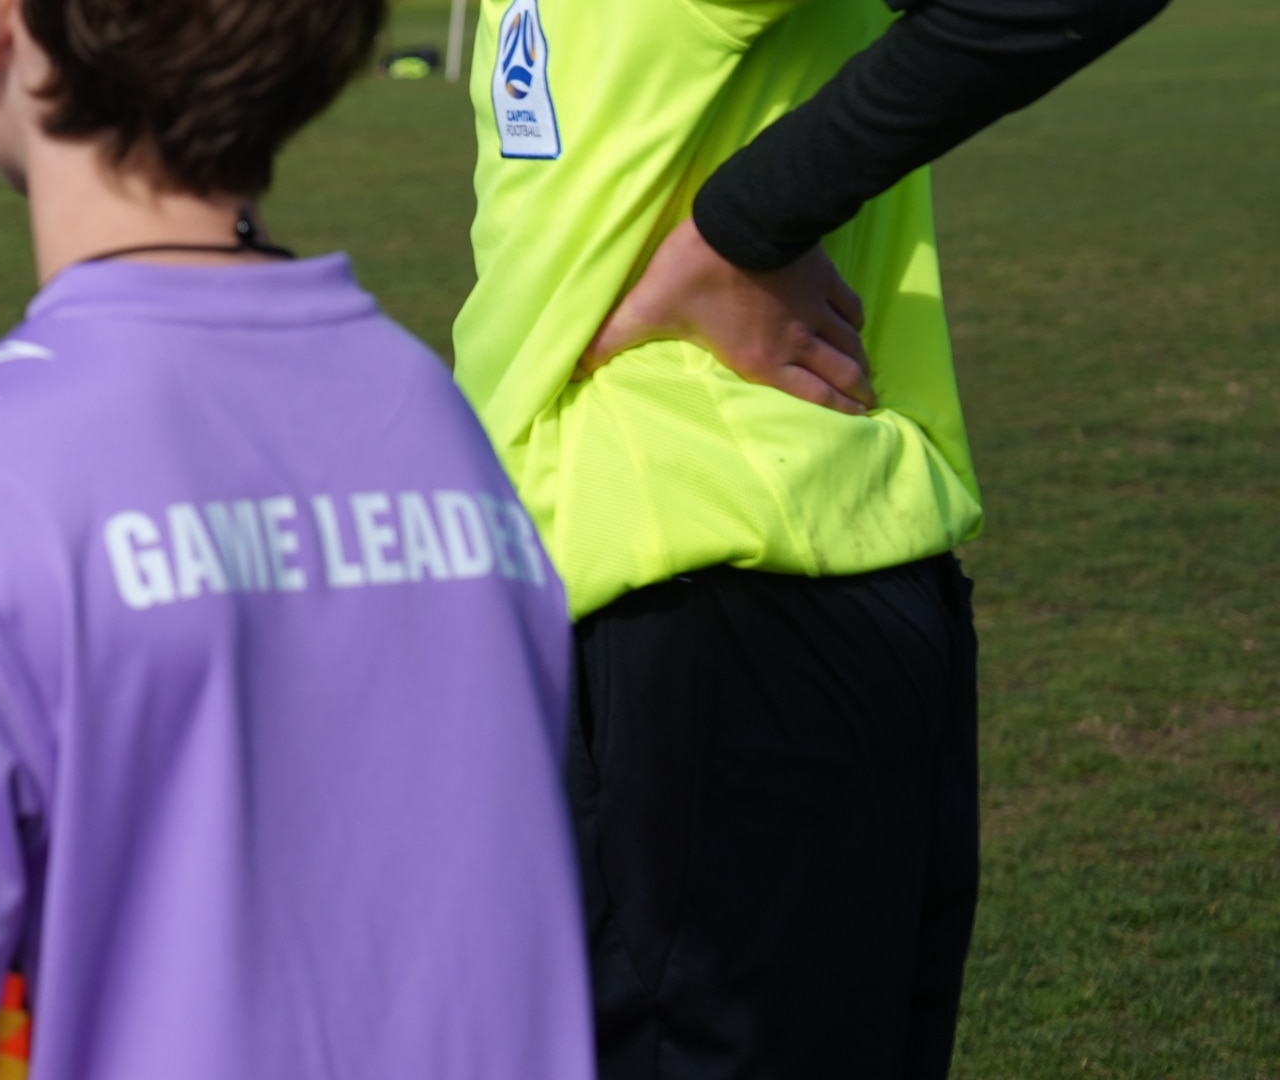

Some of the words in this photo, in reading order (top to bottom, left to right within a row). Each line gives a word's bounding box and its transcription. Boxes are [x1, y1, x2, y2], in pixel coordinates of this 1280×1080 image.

[506, 110, 537, 122] CAPITAL
[505, 124, 542, 137] FOOTBALL
[104, 495, 307, 610] GAME
